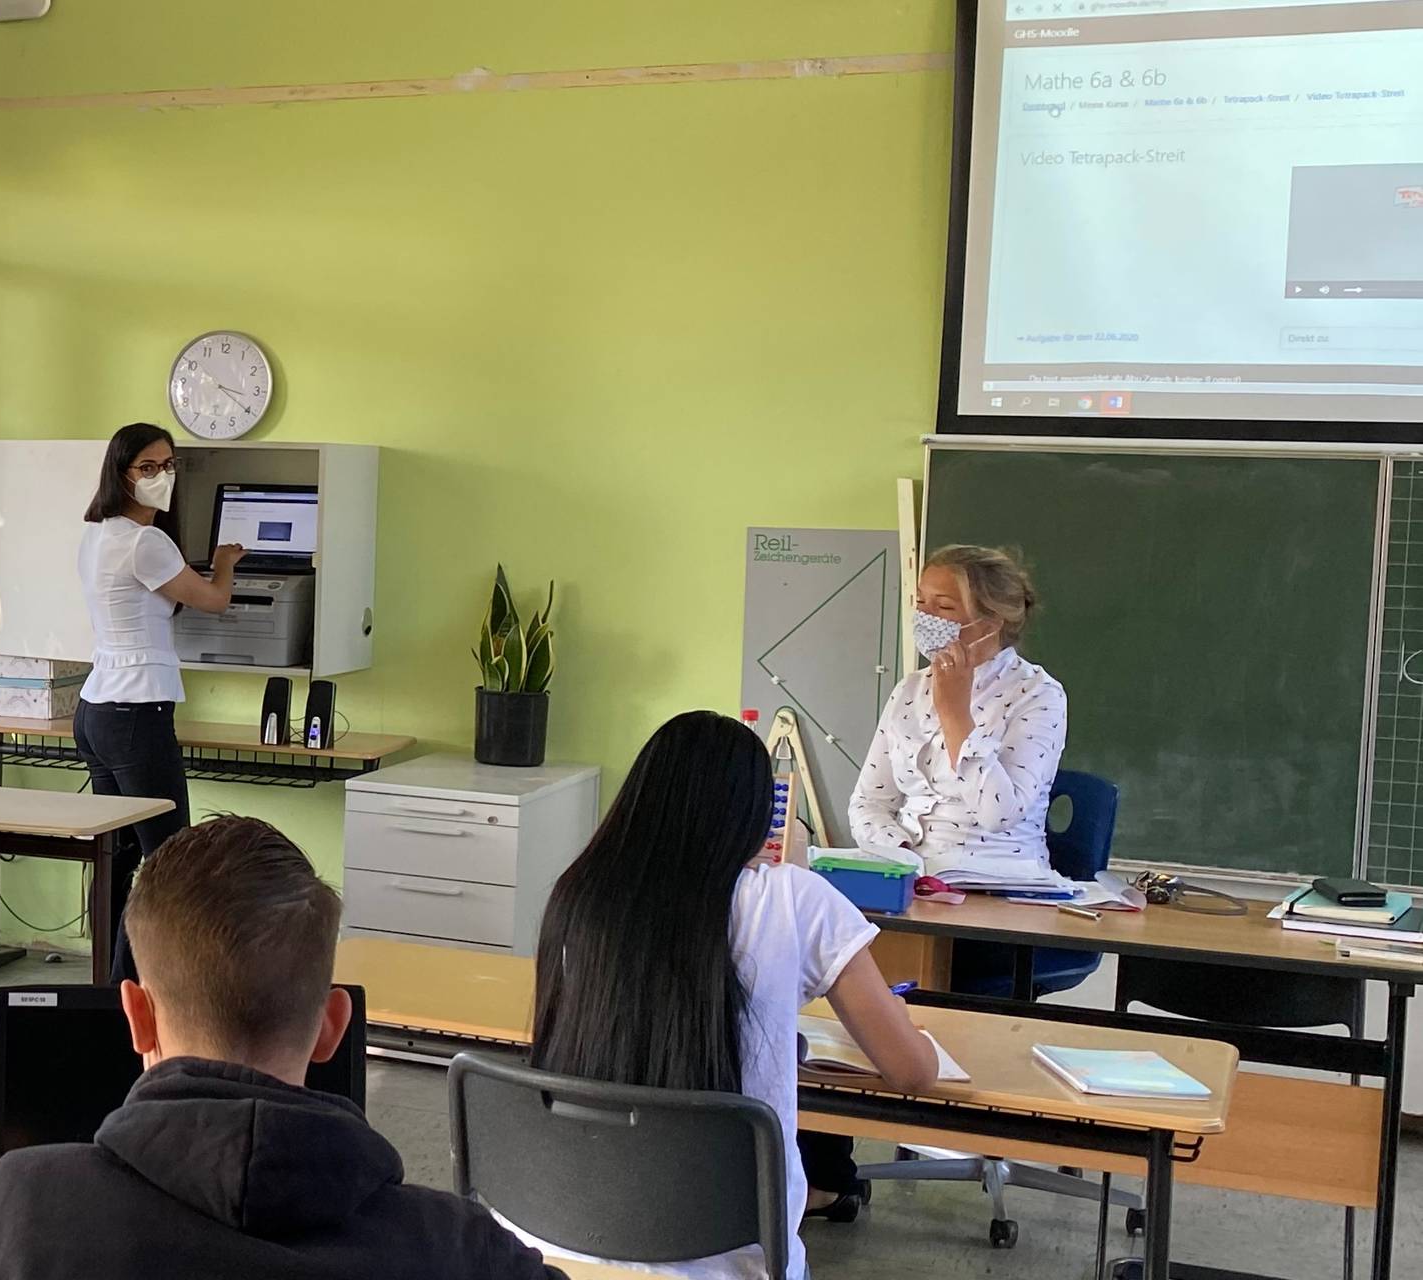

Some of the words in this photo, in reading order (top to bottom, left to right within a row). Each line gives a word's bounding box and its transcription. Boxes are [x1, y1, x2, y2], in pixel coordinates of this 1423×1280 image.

[1014, 27, 1080, 39] GHS-Moodle
[1024, 72, 1084, 91] Mathe
[1090, 71, 1113, 89] 6a
[1120, 70, 1135, 88] &
[1142, 68, 1167, 87] 6b
[1020, 150, 1065, 167] Video
[1070, 149, 1186, 168] Tetrapack-Streit
[203, 346, 212, 358] 11
[221, 343, 231, 354] 12
[187, 360, 198, 371] 10
[249, 365, 258, 377] 2
[253, 385, 261, 397] 3
[182, 397, 189, 408] 8
[209, 419, 217, 430] 6
[228, 416, 237, 427] 5
[753, 533, 800, 552] Reil-
[753, 551, 842, 565] Zeichengeräte
